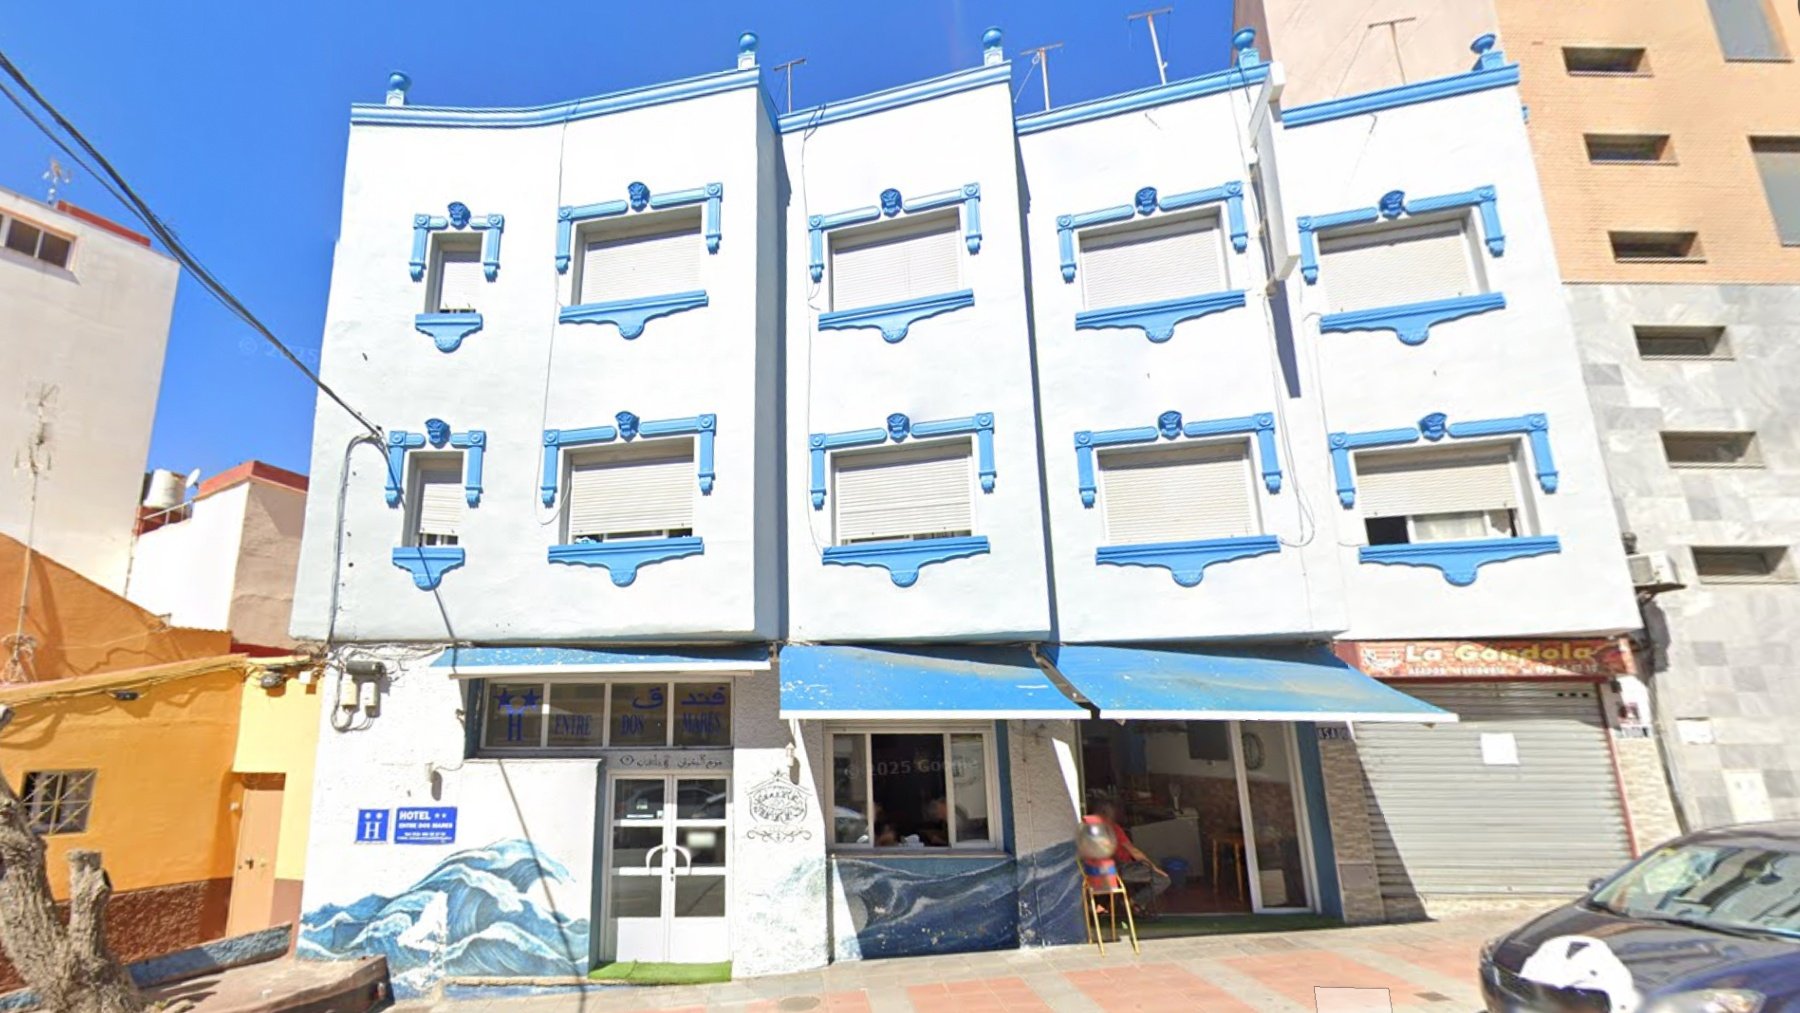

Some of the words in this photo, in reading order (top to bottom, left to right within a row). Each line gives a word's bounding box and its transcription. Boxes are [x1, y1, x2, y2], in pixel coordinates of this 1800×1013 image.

[1405, 644, 1443, 662] La
[555, 714, 593, 736] ENTRE
[398, 810, 431, 821] HOTEL
[363, 821, 382, 840] H
